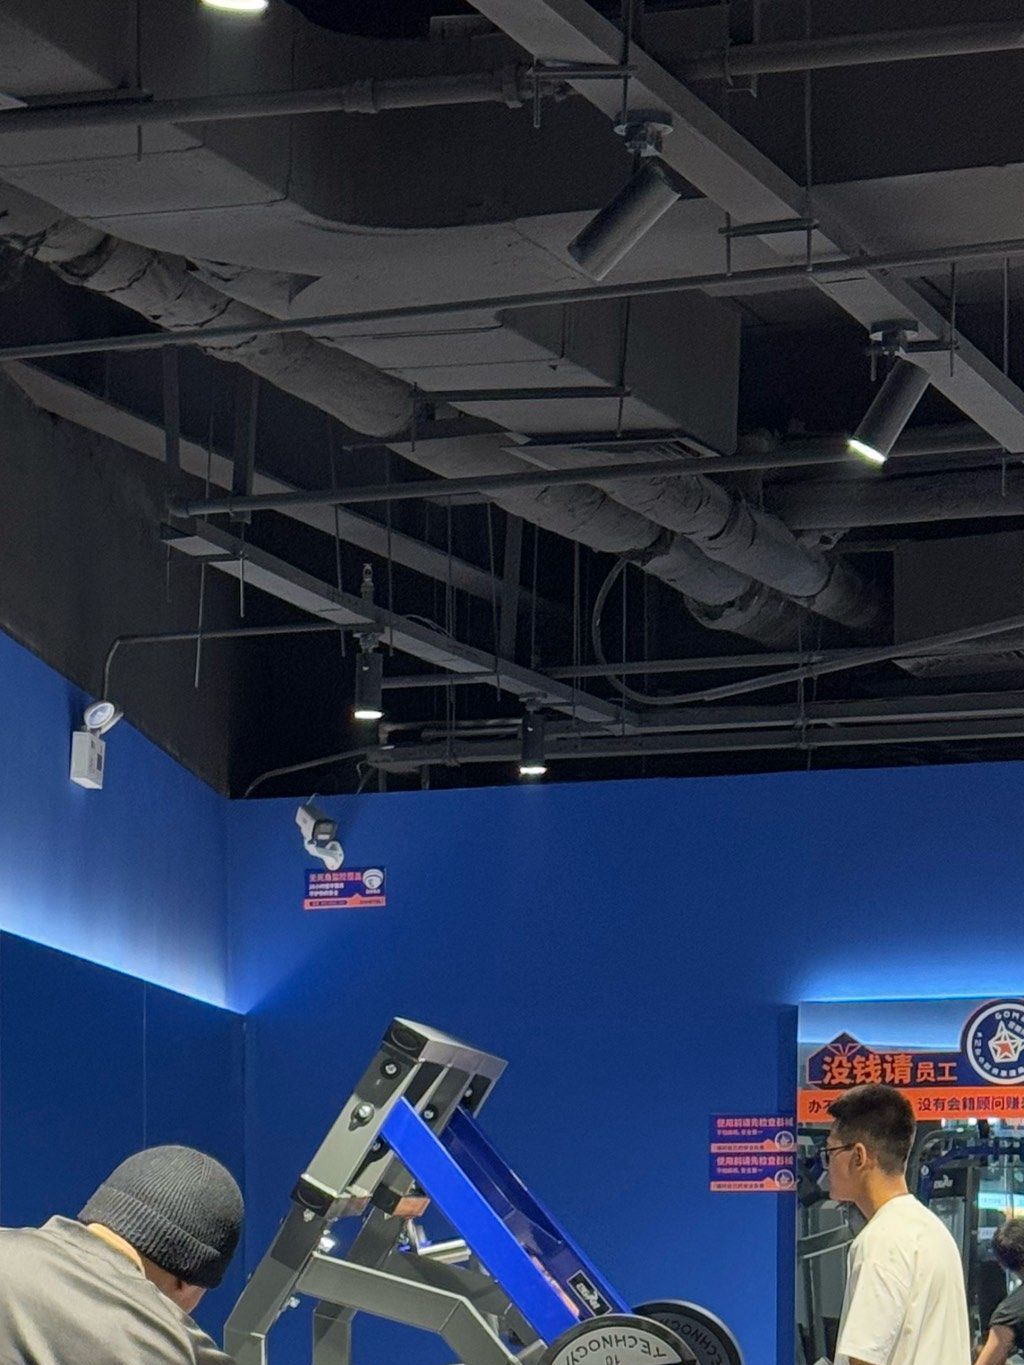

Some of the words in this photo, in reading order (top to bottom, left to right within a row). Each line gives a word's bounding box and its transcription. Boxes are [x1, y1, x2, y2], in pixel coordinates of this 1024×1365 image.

[822, 1052, 958, 1086] 没钱请员工
[918, 1096, 1024, 1112] 没有会籍顾问赚
